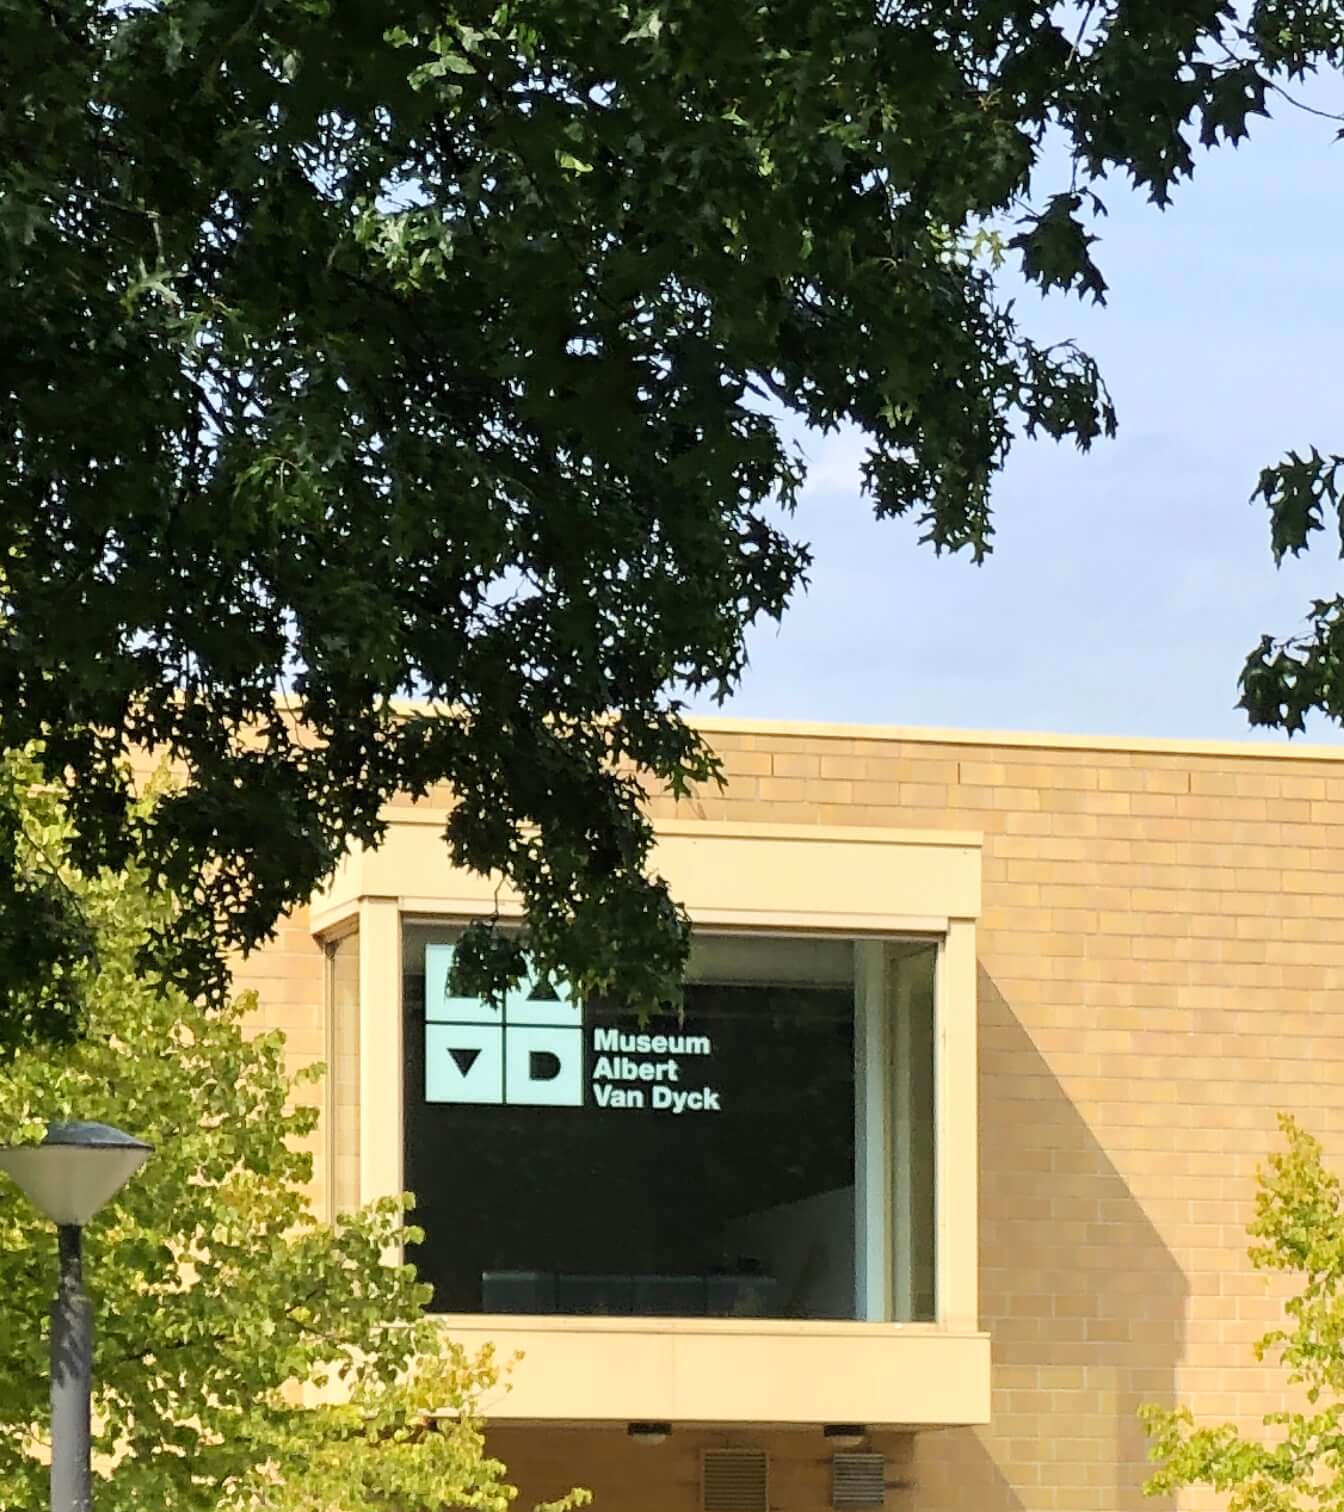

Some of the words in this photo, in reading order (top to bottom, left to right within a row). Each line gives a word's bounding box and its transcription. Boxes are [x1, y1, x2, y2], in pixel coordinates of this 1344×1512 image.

[593, 1027, 711, 1055] Museum
[592, 1055, 680, 1082] Albert
[592, 1083, 645, 1109] Van
[651, 1085, 721, 1114] Dyck
